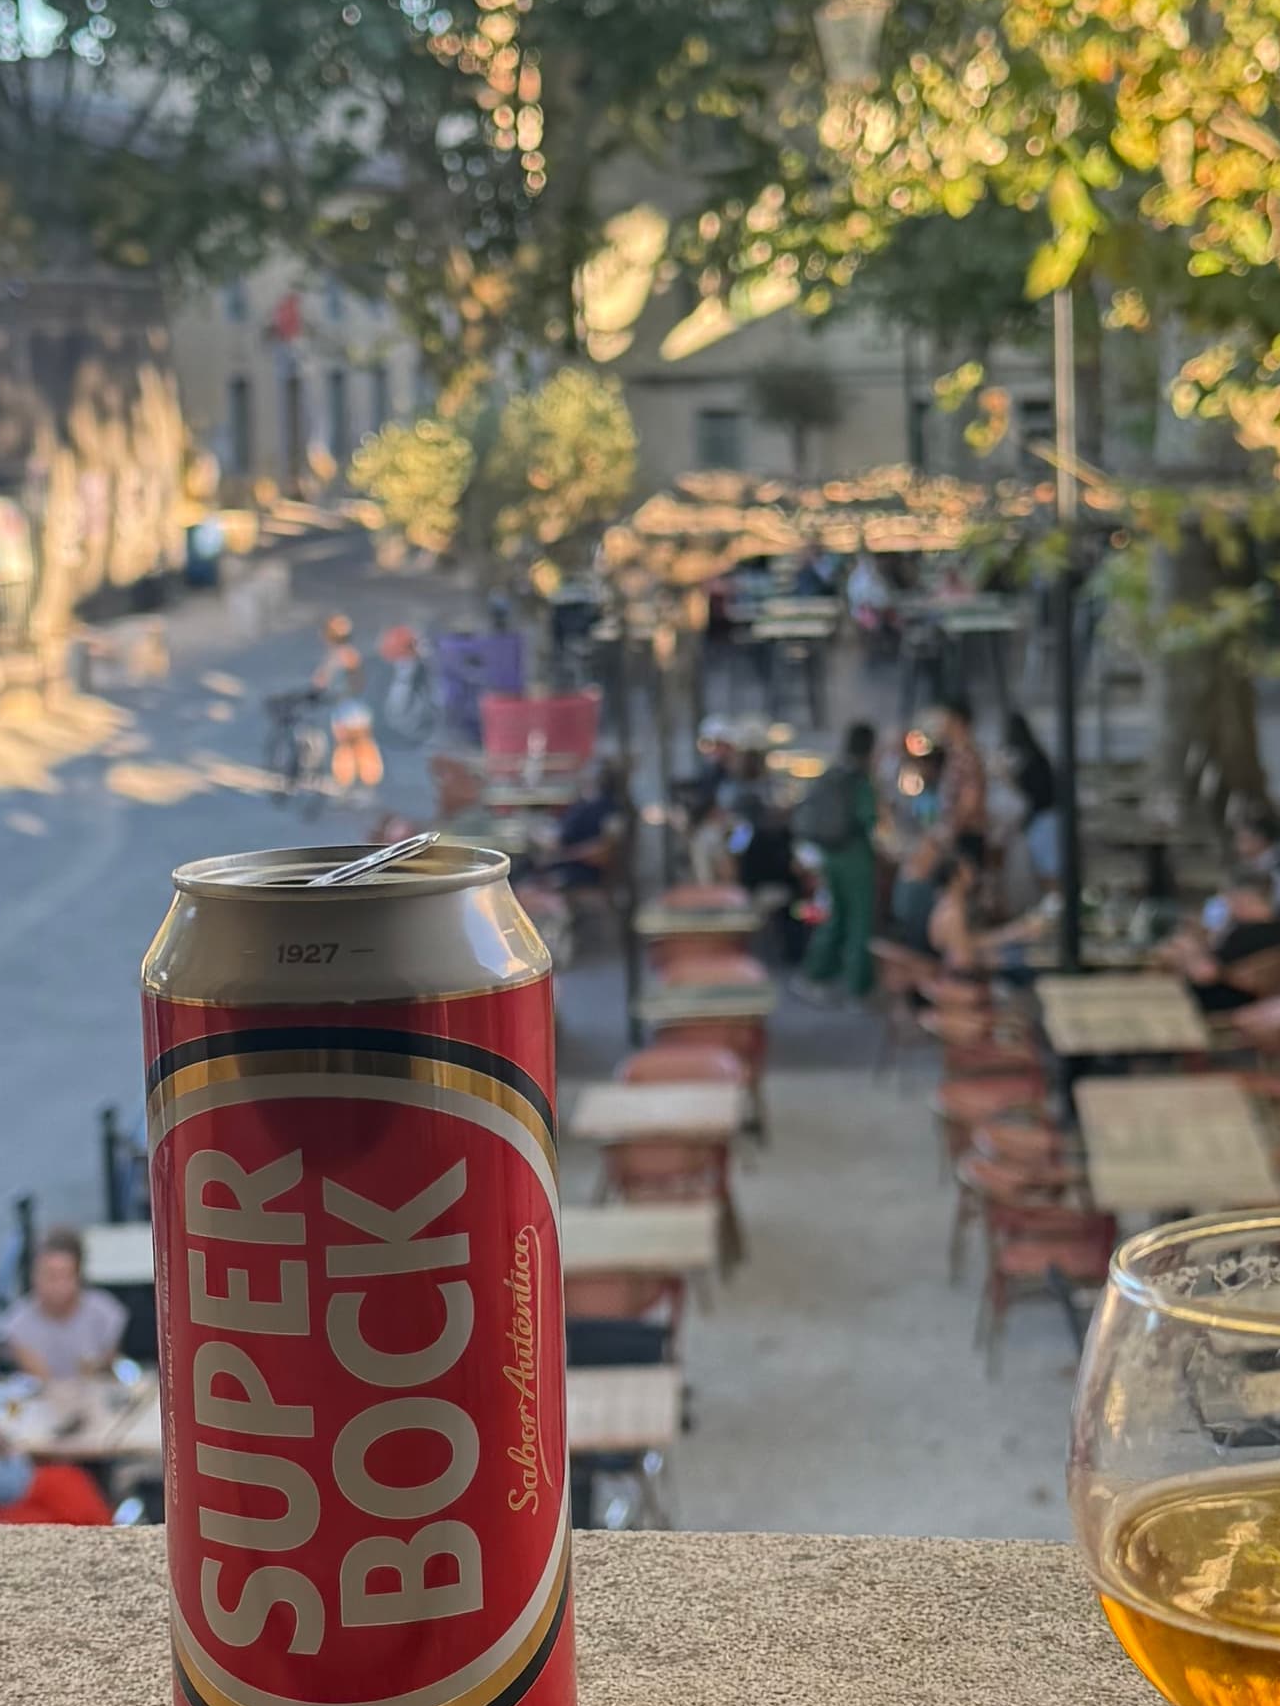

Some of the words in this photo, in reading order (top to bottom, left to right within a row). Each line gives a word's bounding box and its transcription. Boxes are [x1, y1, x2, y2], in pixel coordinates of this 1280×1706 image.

[276, 943, 340, 964] 1927
[185, 1148, 326, 1655] SUPER
[321, 1156, 484, 1628] BOCK
[507, 1404, 540, 1516] Sabor
